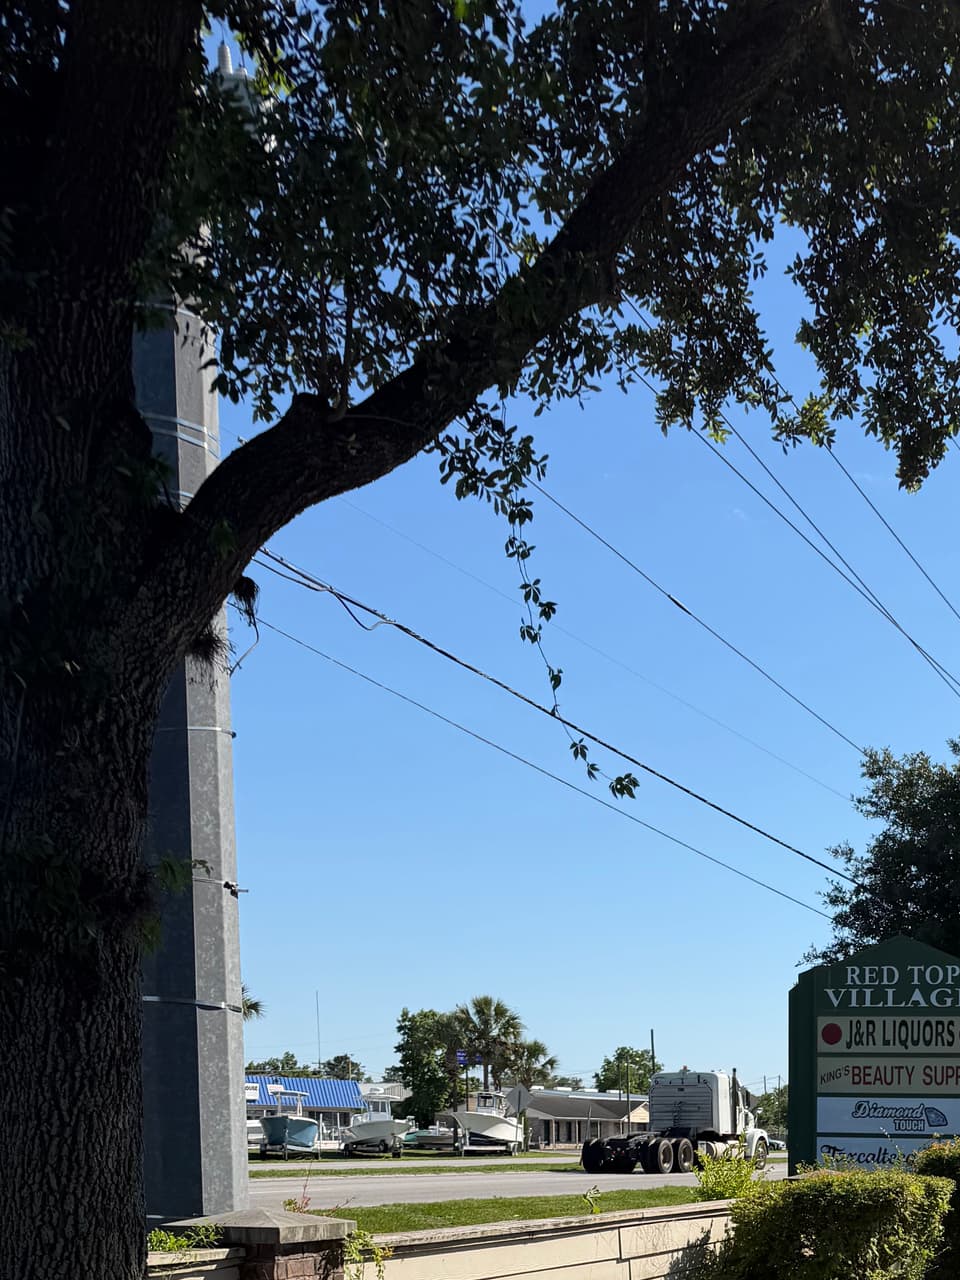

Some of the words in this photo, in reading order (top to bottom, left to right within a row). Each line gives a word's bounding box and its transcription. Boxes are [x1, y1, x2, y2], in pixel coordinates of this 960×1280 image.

[846, 965, 899, 985] RED
[907, 965, 960, 985] TOP
[846, 1020, 876, 1049] J&R
[882, 1020, 955, 1049] LIQUORS
[820, 1065, 850, 1085] KING'S
[852, 1066, 915, 1085] BEAUTY
[852, 1100, 925, 1118] Diamond
[893, 1119, 925, 1131] TOUCH
